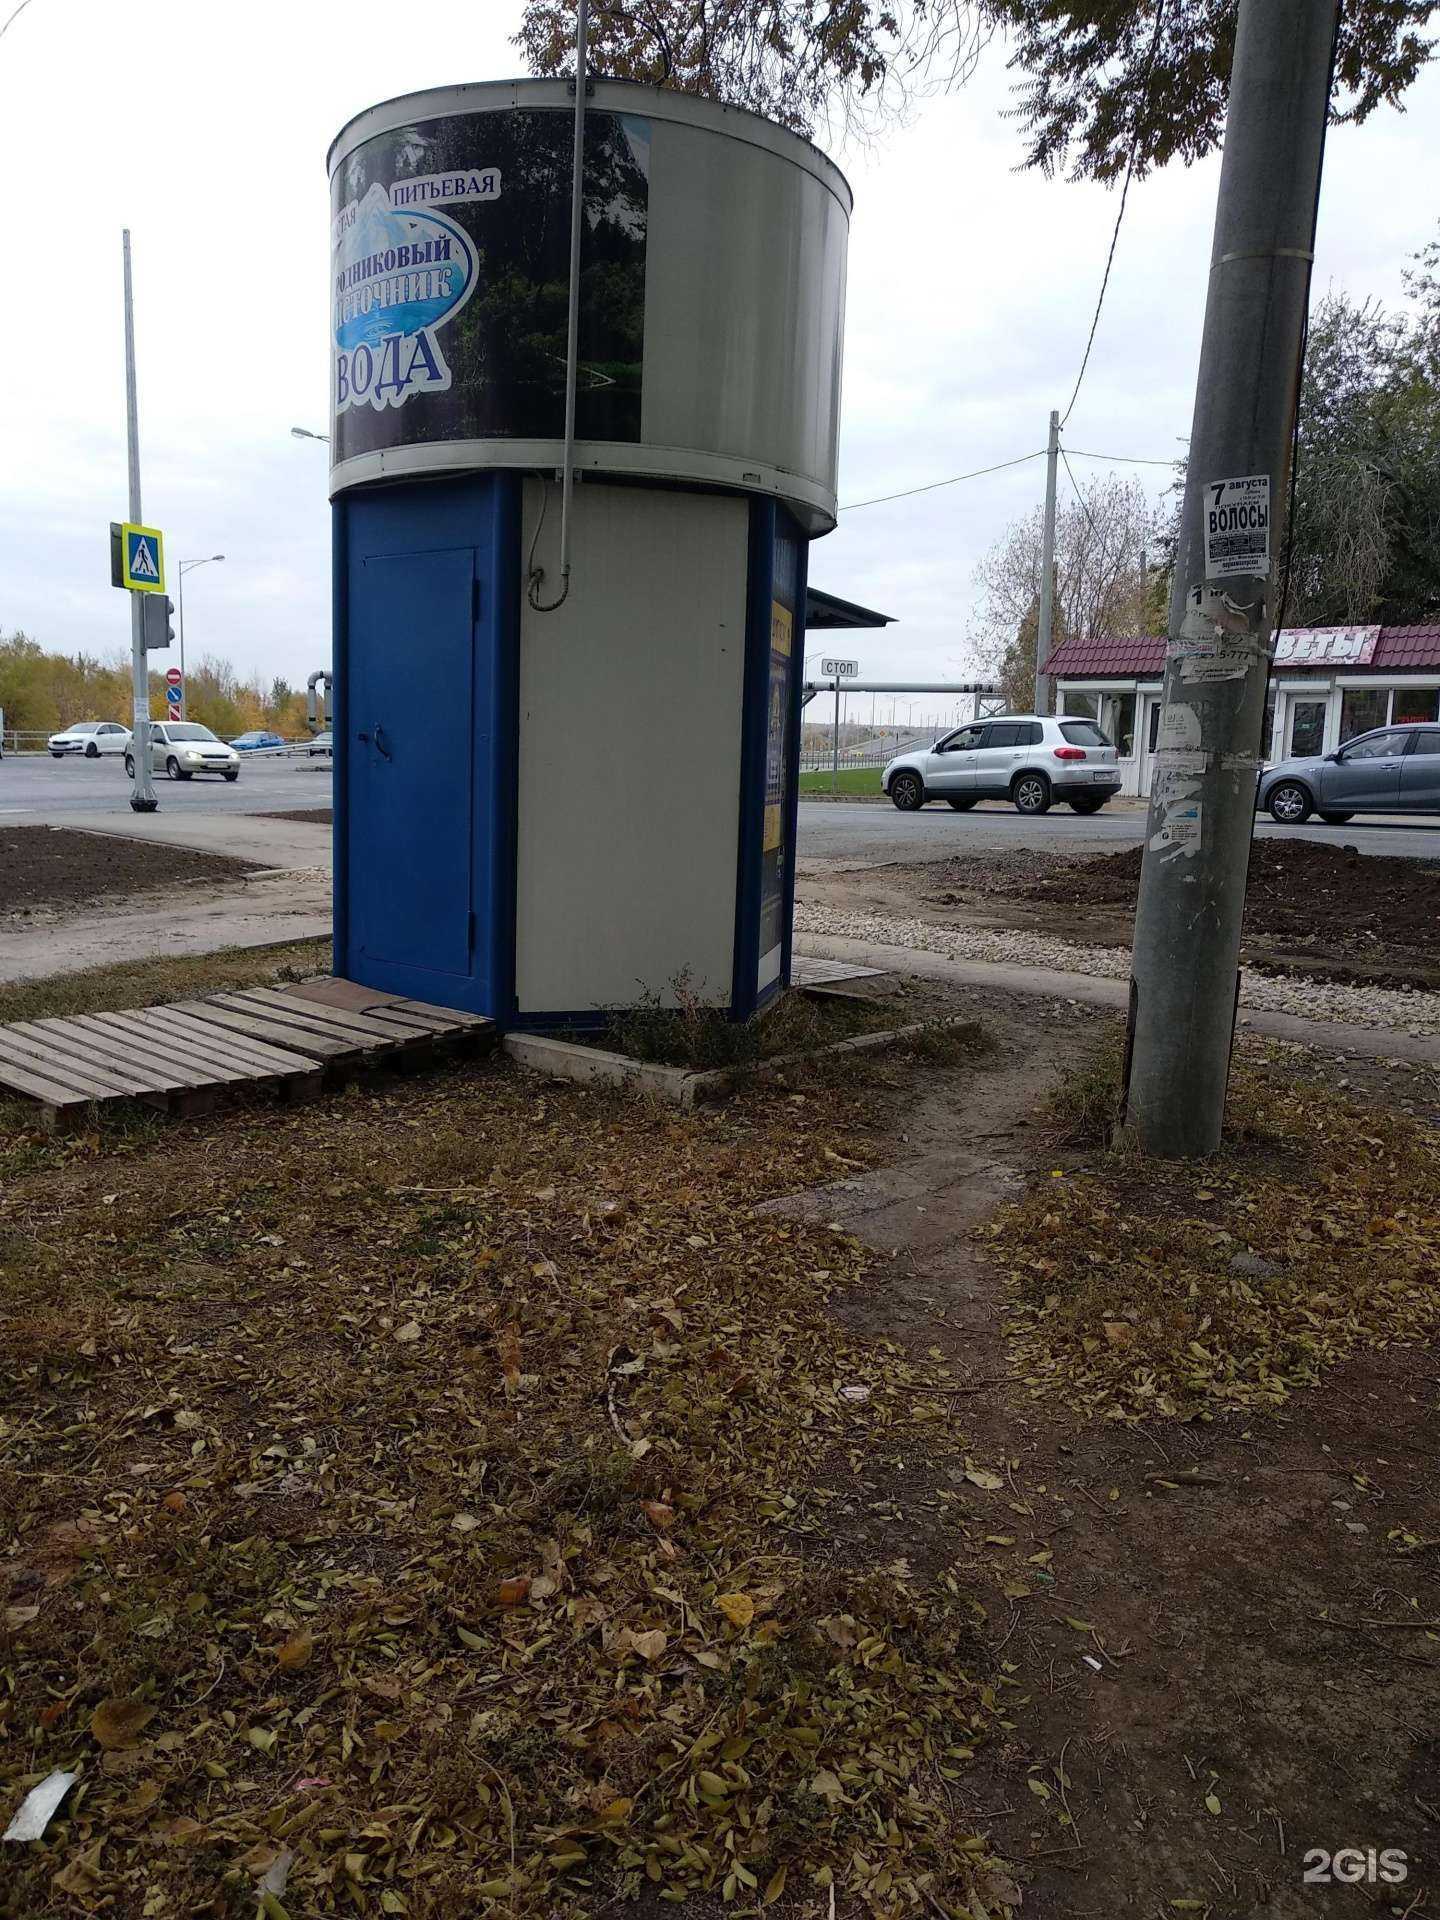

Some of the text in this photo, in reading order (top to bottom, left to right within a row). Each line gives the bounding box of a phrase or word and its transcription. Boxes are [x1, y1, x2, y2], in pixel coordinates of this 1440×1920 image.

[336, 176, 495, 237] СТАЯ ПИТЬЕВАЯ
[337, 334, 443, 402] ВОДА
[1211, 479, 1268, 506] 7 августа
[1209, 505, 1268, 533] ВОЛОСЫ
[1274, 632, 1366, 660] ВЕТЫ
[826, 662, 853, 674] СТОП
